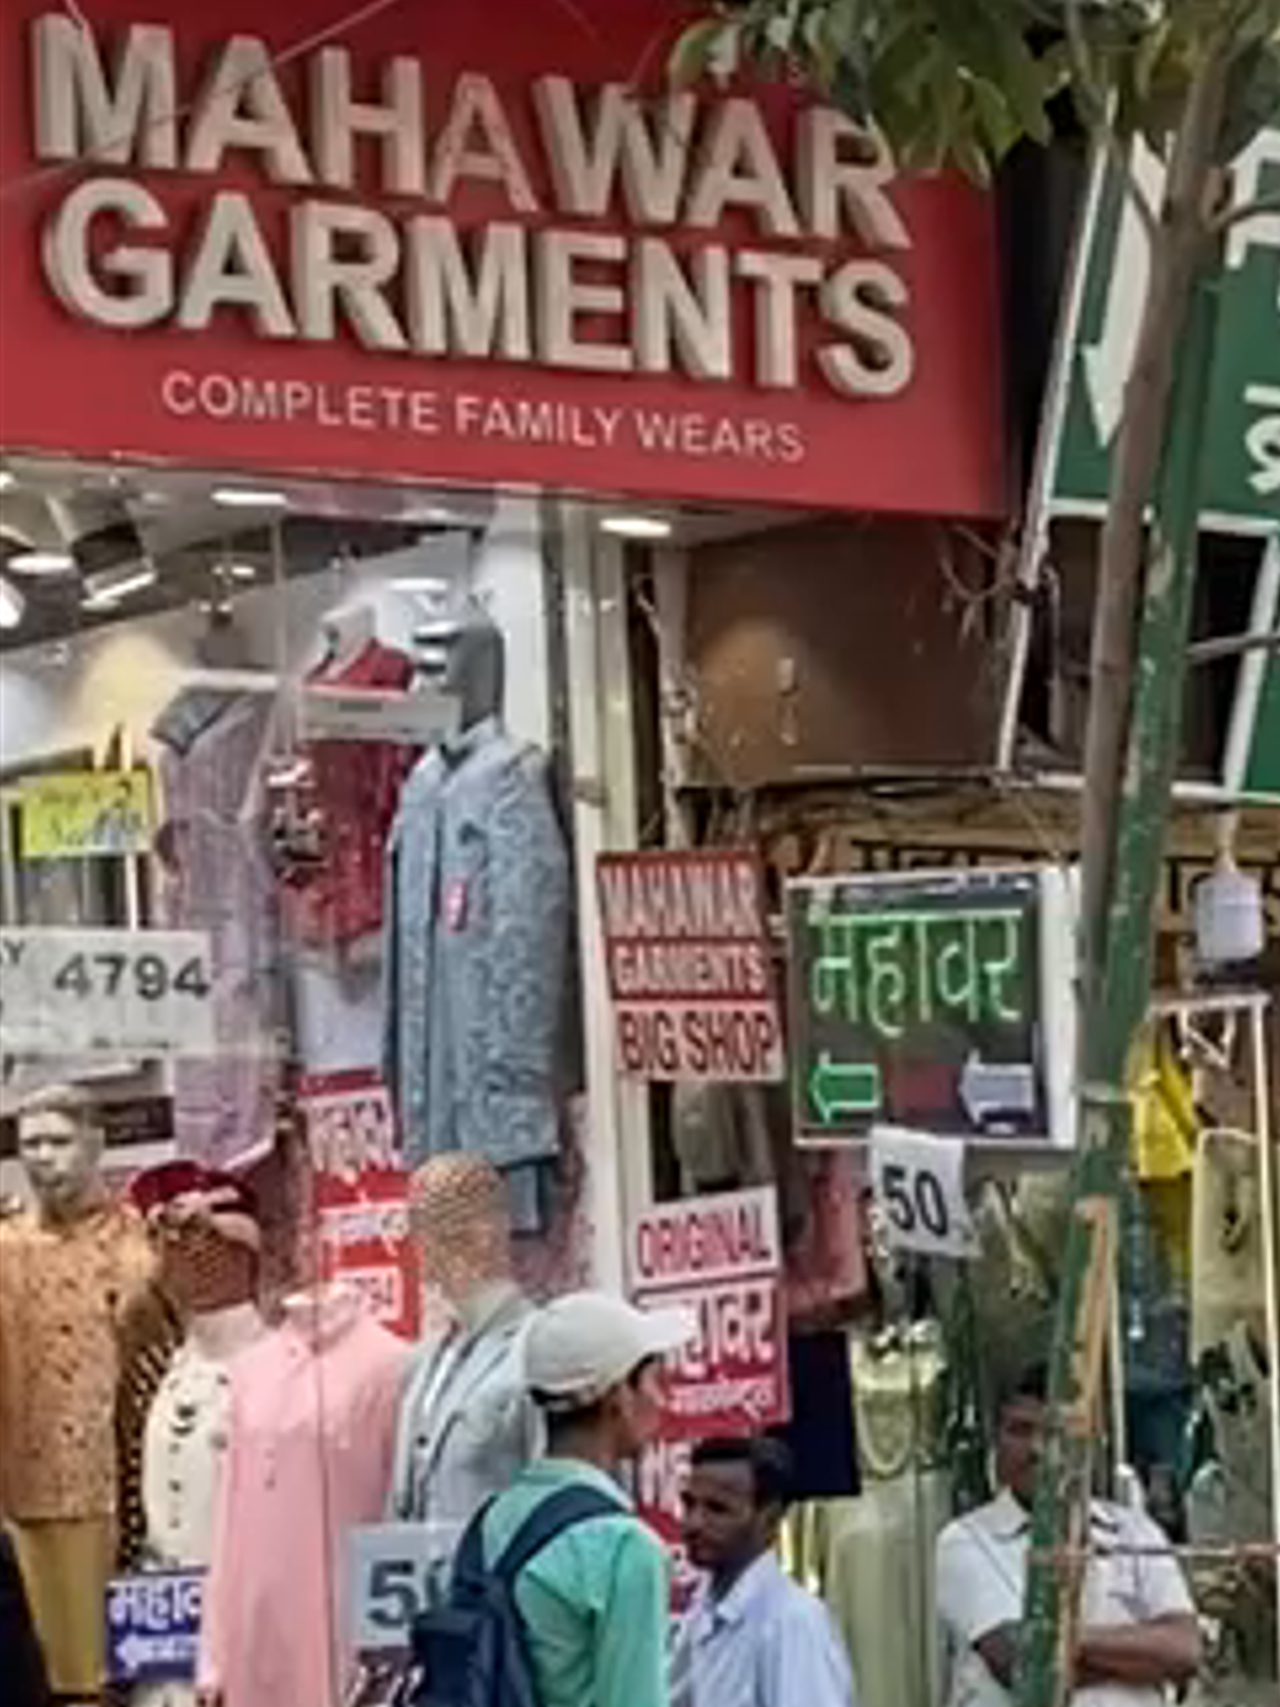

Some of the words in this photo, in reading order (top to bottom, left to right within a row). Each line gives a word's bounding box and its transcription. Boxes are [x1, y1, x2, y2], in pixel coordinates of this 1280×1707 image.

[31, 12, 912, 250] MAHAWAR
[41, 178, 915, 398] GARMENTS
[162, 369, 437, 434] COMPLETE
[455, 393, 621, 448] FAMILY
[635, 407, 805, 464] WEARS
[54, 952, 211, 1001] 4794
[806, 909, 1023, 1037] महावर
[619, 1010, 681, 1072] BIG
[684, 1010, 775, 1074] SHOP
[881, 1163, 949, 1238] 50
[108, 1575, 201, 1631] महा
